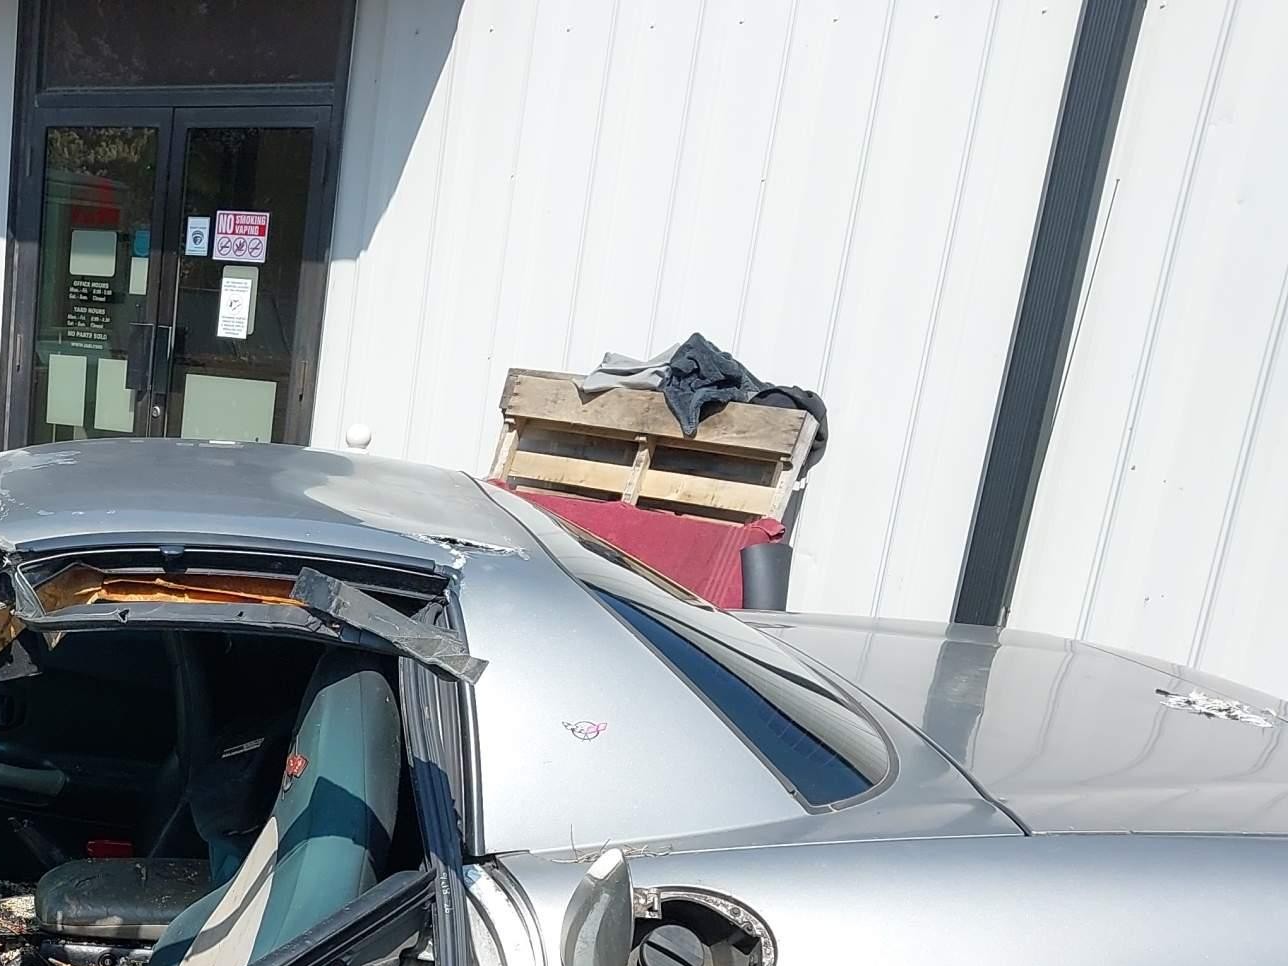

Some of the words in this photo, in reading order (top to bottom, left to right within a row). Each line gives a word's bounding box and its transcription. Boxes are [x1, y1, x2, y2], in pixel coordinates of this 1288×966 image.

[218, 213, 234, 233] NO
[235, 214, 267, 225] SMOKING
[235, 225, 260, 236] VAPING
